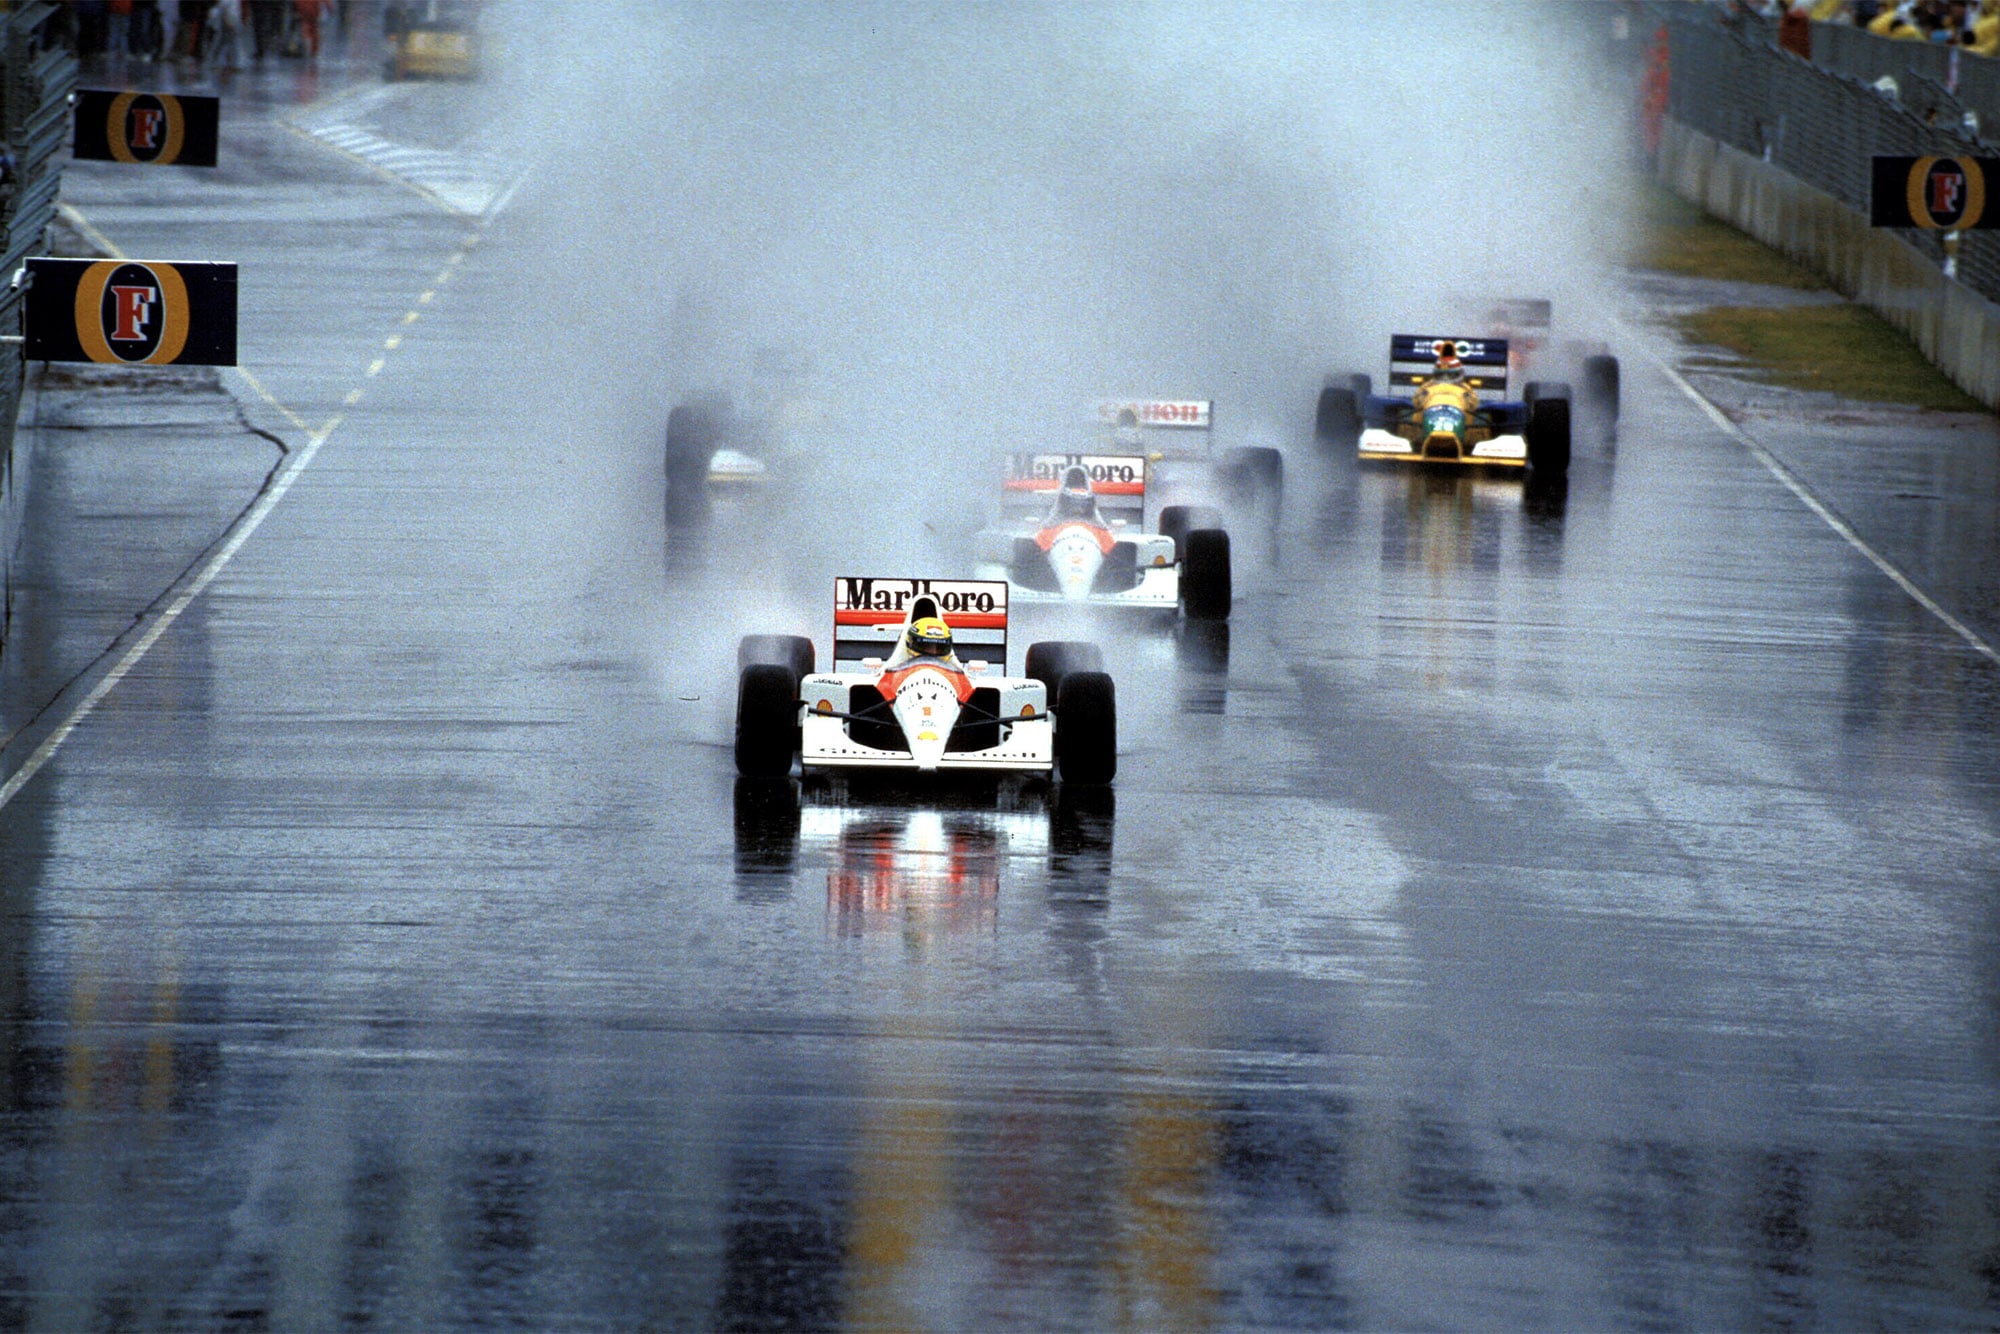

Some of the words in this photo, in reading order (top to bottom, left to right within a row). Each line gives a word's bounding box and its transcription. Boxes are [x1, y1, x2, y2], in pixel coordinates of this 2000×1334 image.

[132, 109, 161, 148] F
[1932, 173, 1962, 212] F
[111, 285, 156, 341] F
[845, 579, 994, 612] Marlboro
